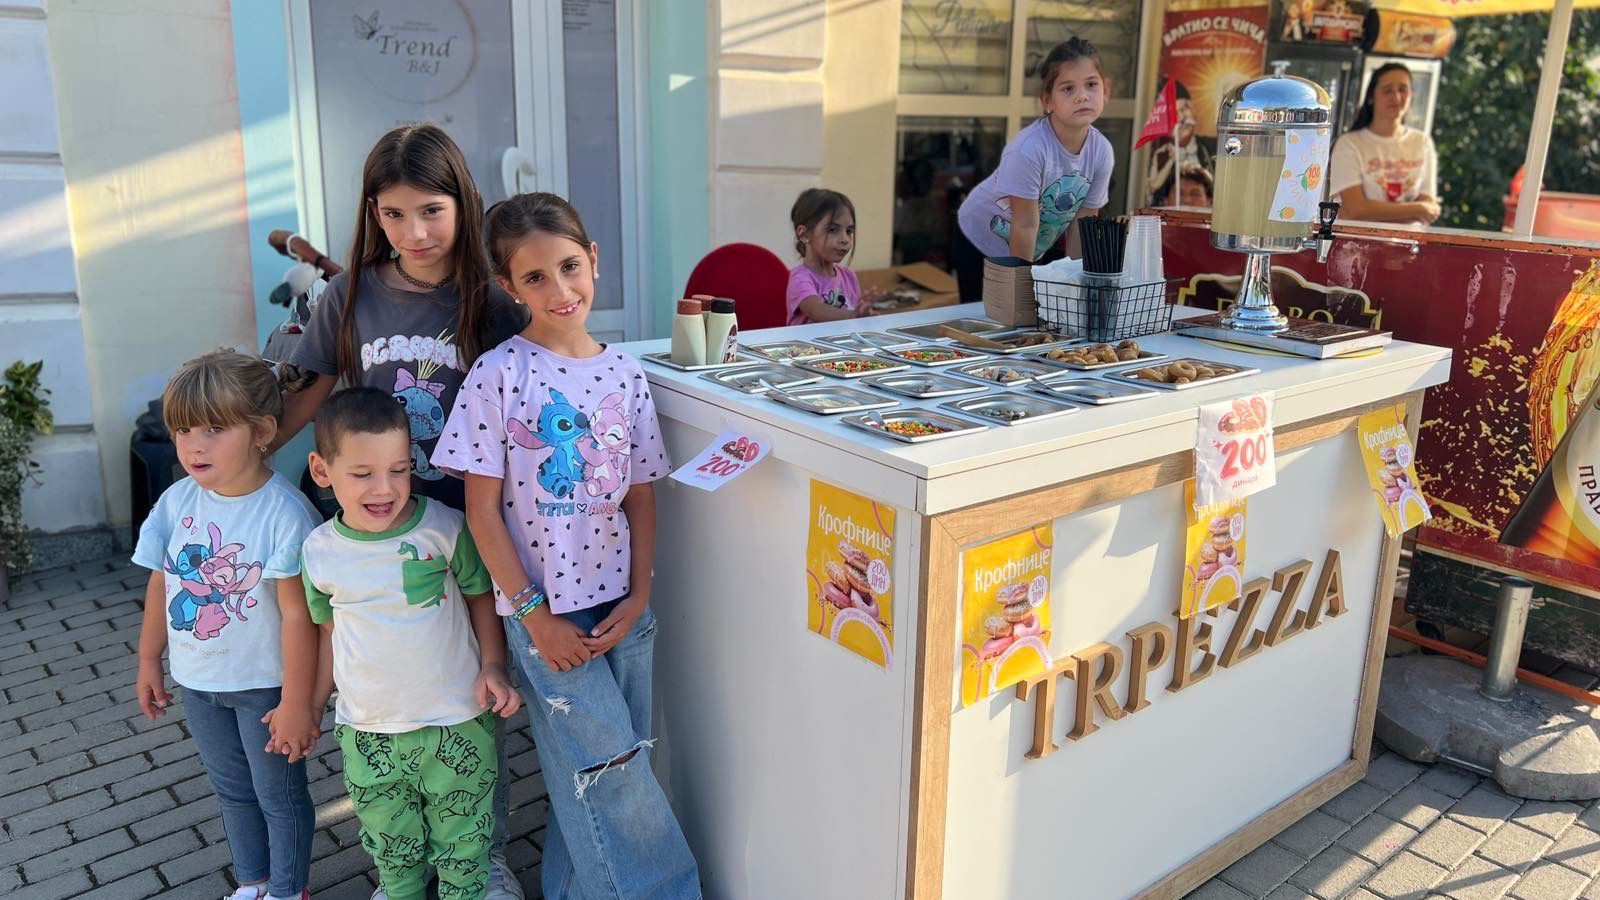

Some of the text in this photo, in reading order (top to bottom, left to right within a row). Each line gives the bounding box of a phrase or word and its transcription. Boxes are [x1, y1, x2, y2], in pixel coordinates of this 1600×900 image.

[376, 35, 457, 57] Trend
[1213, 16, 1229, 30] СЕ
[1232, 17, 1265, 44] ЧИЧА
[696, 455, 740, 476] 200
[1220, 434, 1266, 480] 200
[818, 503, 892, 556] Крофнице
[871, 560, 887, 577] 200
[974, 548, 1050, 592] Крофнице
[1014, 548, 1348, 760] TRPEZZA
